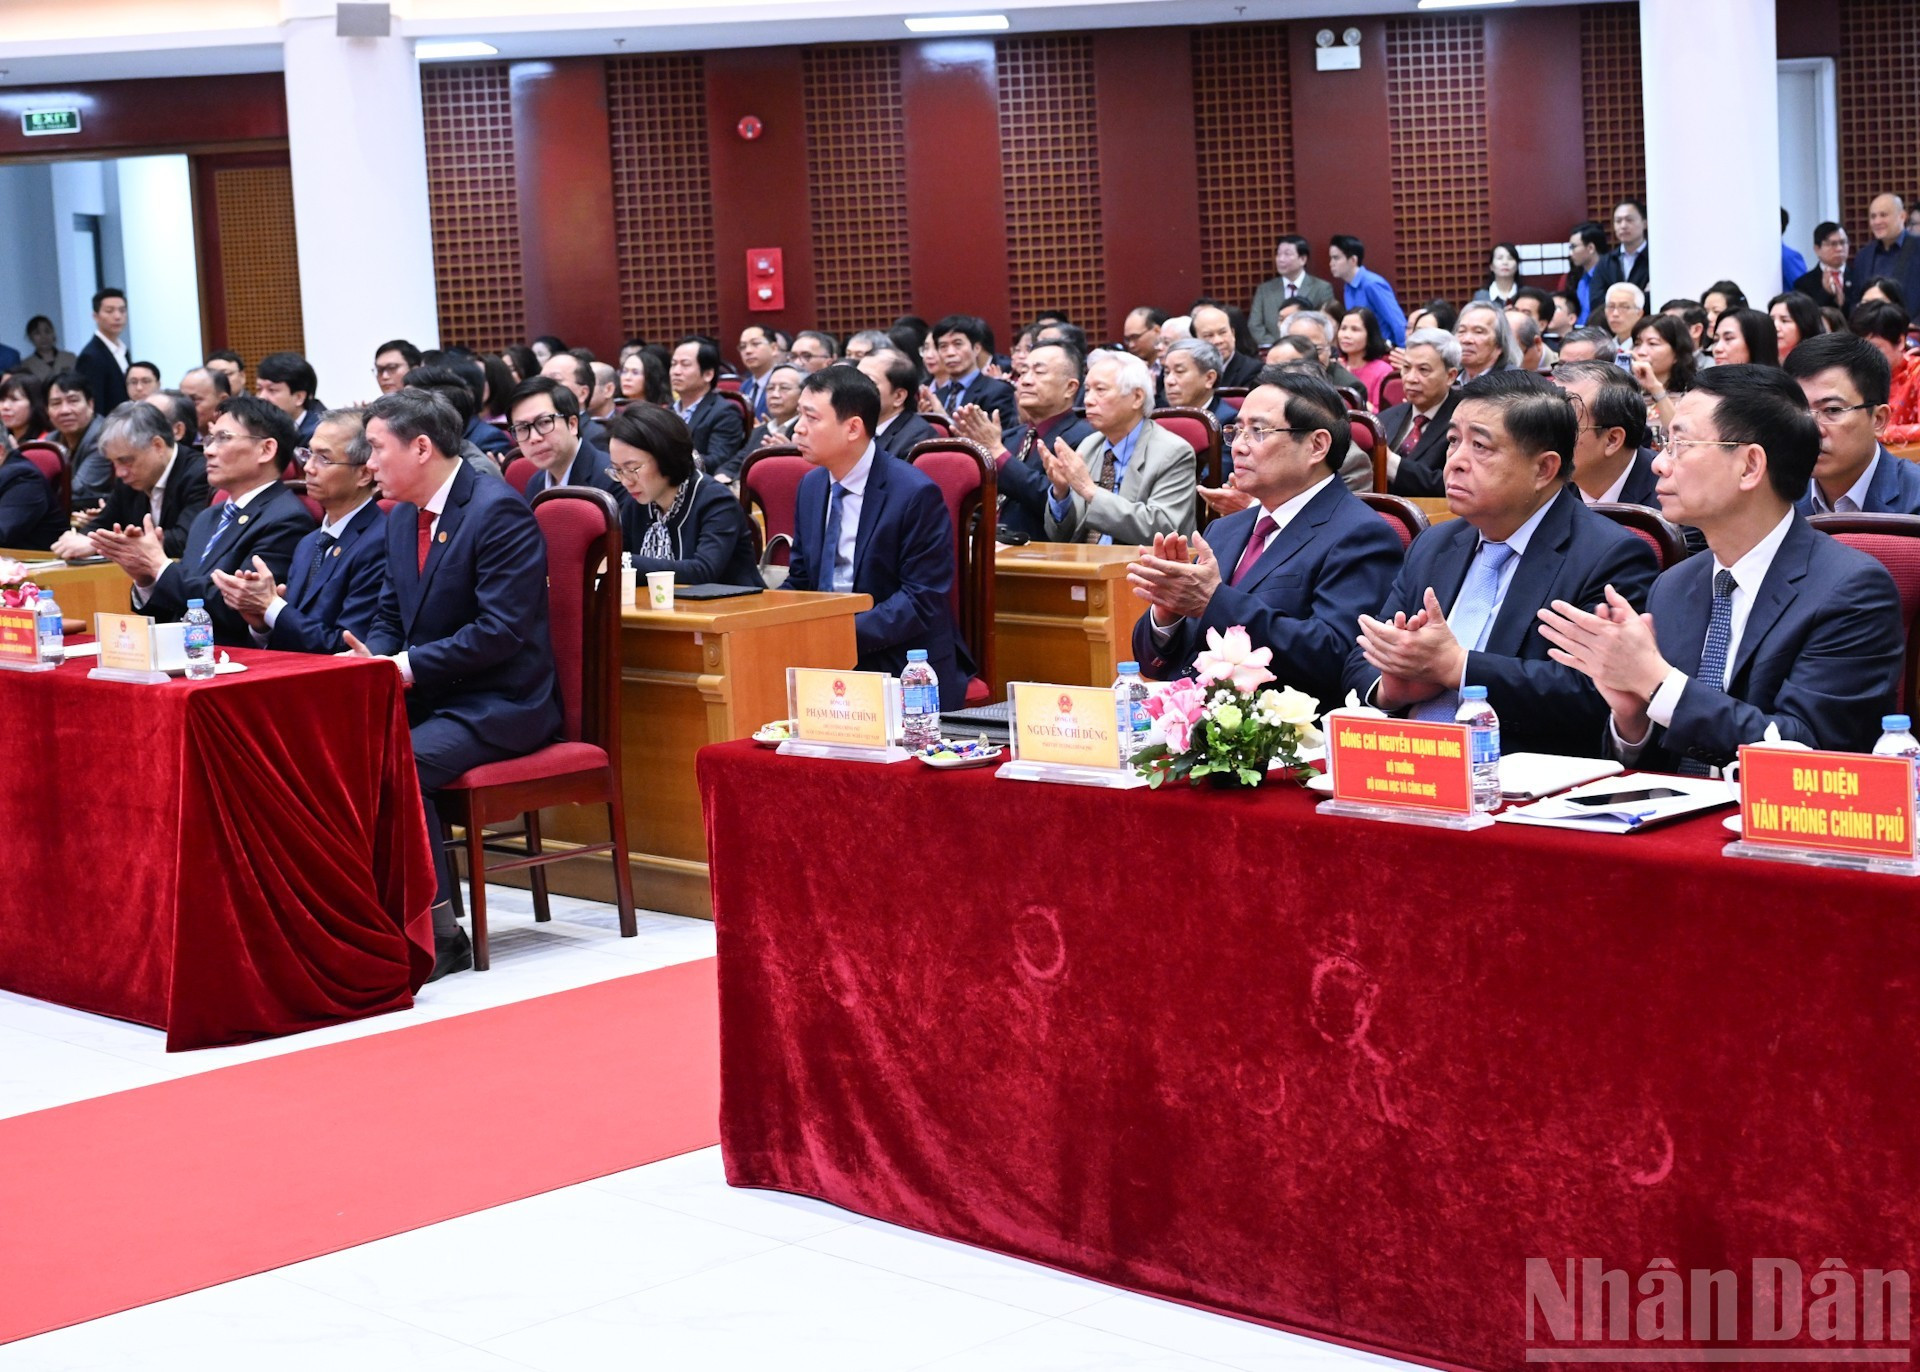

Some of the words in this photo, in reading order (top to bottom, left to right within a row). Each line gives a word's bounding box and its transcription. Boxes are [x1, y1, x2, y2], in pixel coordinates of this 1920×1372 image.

[32, 111, 69, 125] EXIT
[806, 707, 828, 720] PHẠM
[829, 709, 850, 721] MINH
[852, 709, 877, 722] CHÍNH
[1065, 725, 1081, 739] CHÍ
[1083, 726, 1108, 741] DŨNG
[1340, 727, 1362, 749] ĐỒNG
[1363, 731, 1377, 750] CHÍ
[1378, 732, 1411, 754] NGUYỄN
[1412, 738, 1437, 758] MẠNH
[1438, 737, 1461, 758] HÙNG
[1792, 767, 1818, 797] ĐẠI
[1822, 767, 1859, 800] DIỆN
[1752, 797, 1778, 830] VĂN
[1781, 800, 1828, 836] PHÒNG
[1831, 806, 1873, 840] CHÍNH
[1876, 806, 1905, 843] PHỦ
